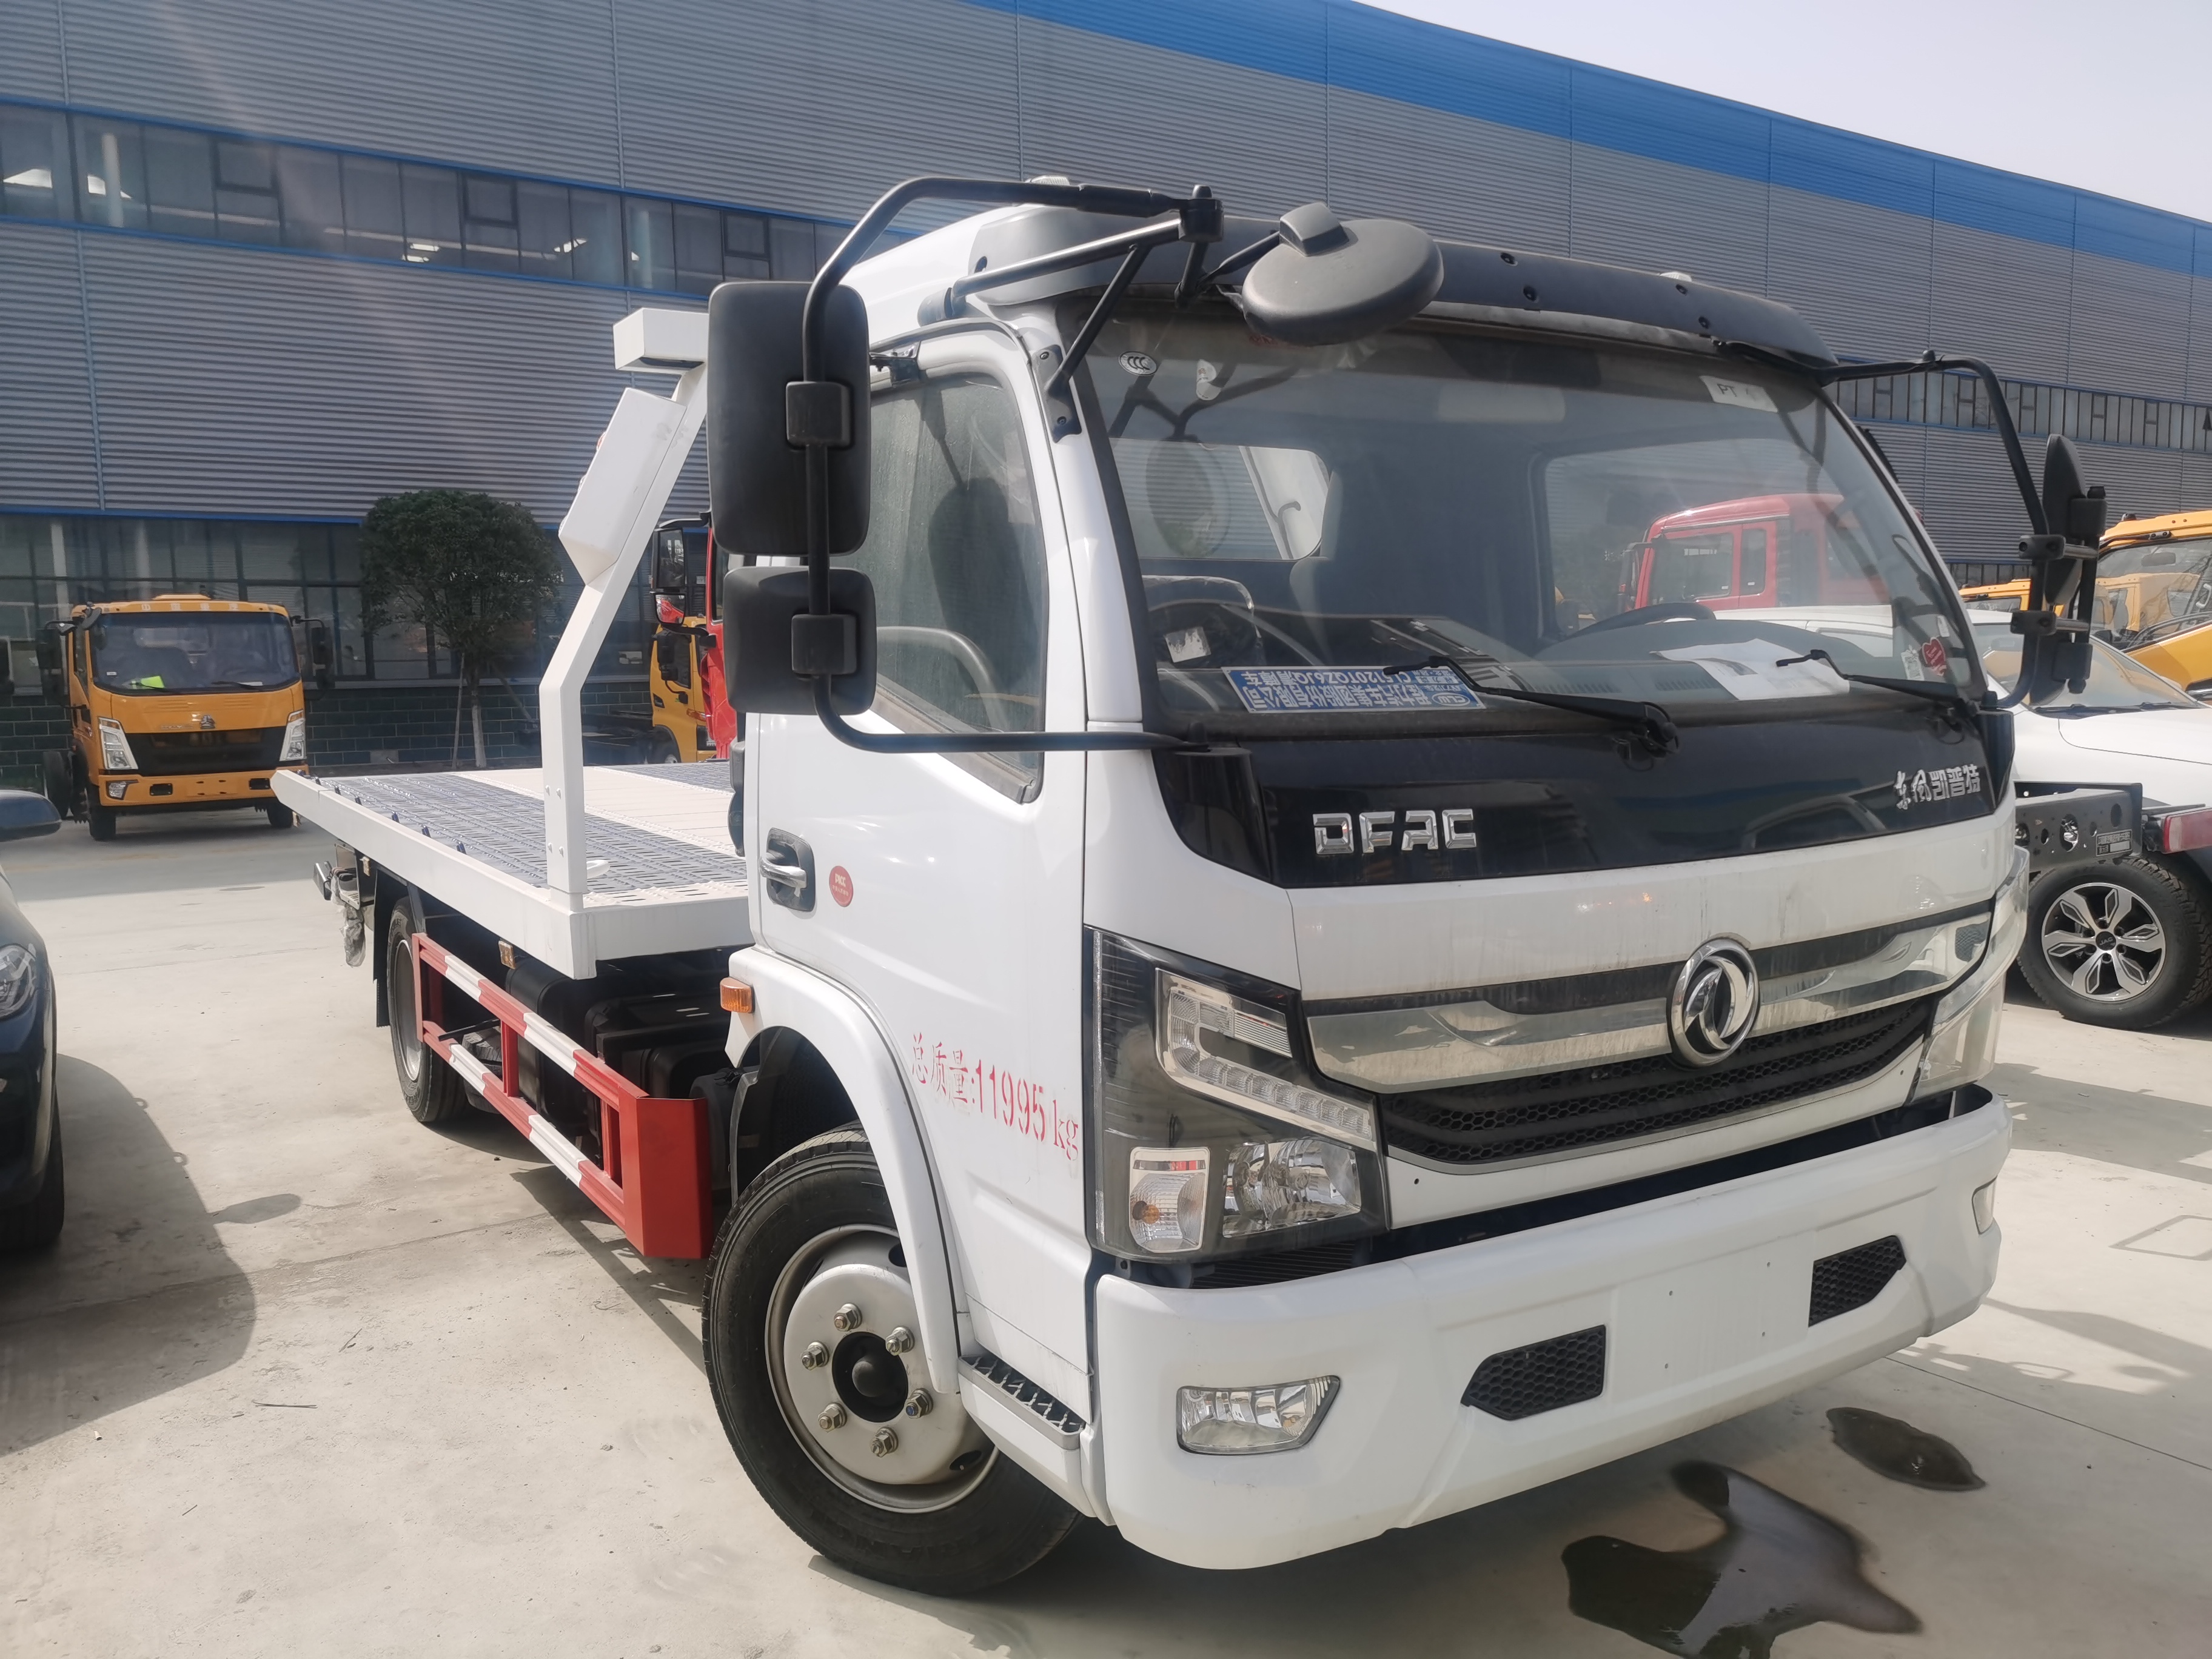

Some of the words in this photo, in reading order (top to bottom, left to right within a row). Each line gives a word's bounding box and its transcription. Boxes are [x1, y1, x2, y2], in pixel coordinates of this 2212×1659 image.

[1242, 683, 1432, 708] 程力汽车集团股份有限公司
[1312, 808, 1476, 854] DFAC
